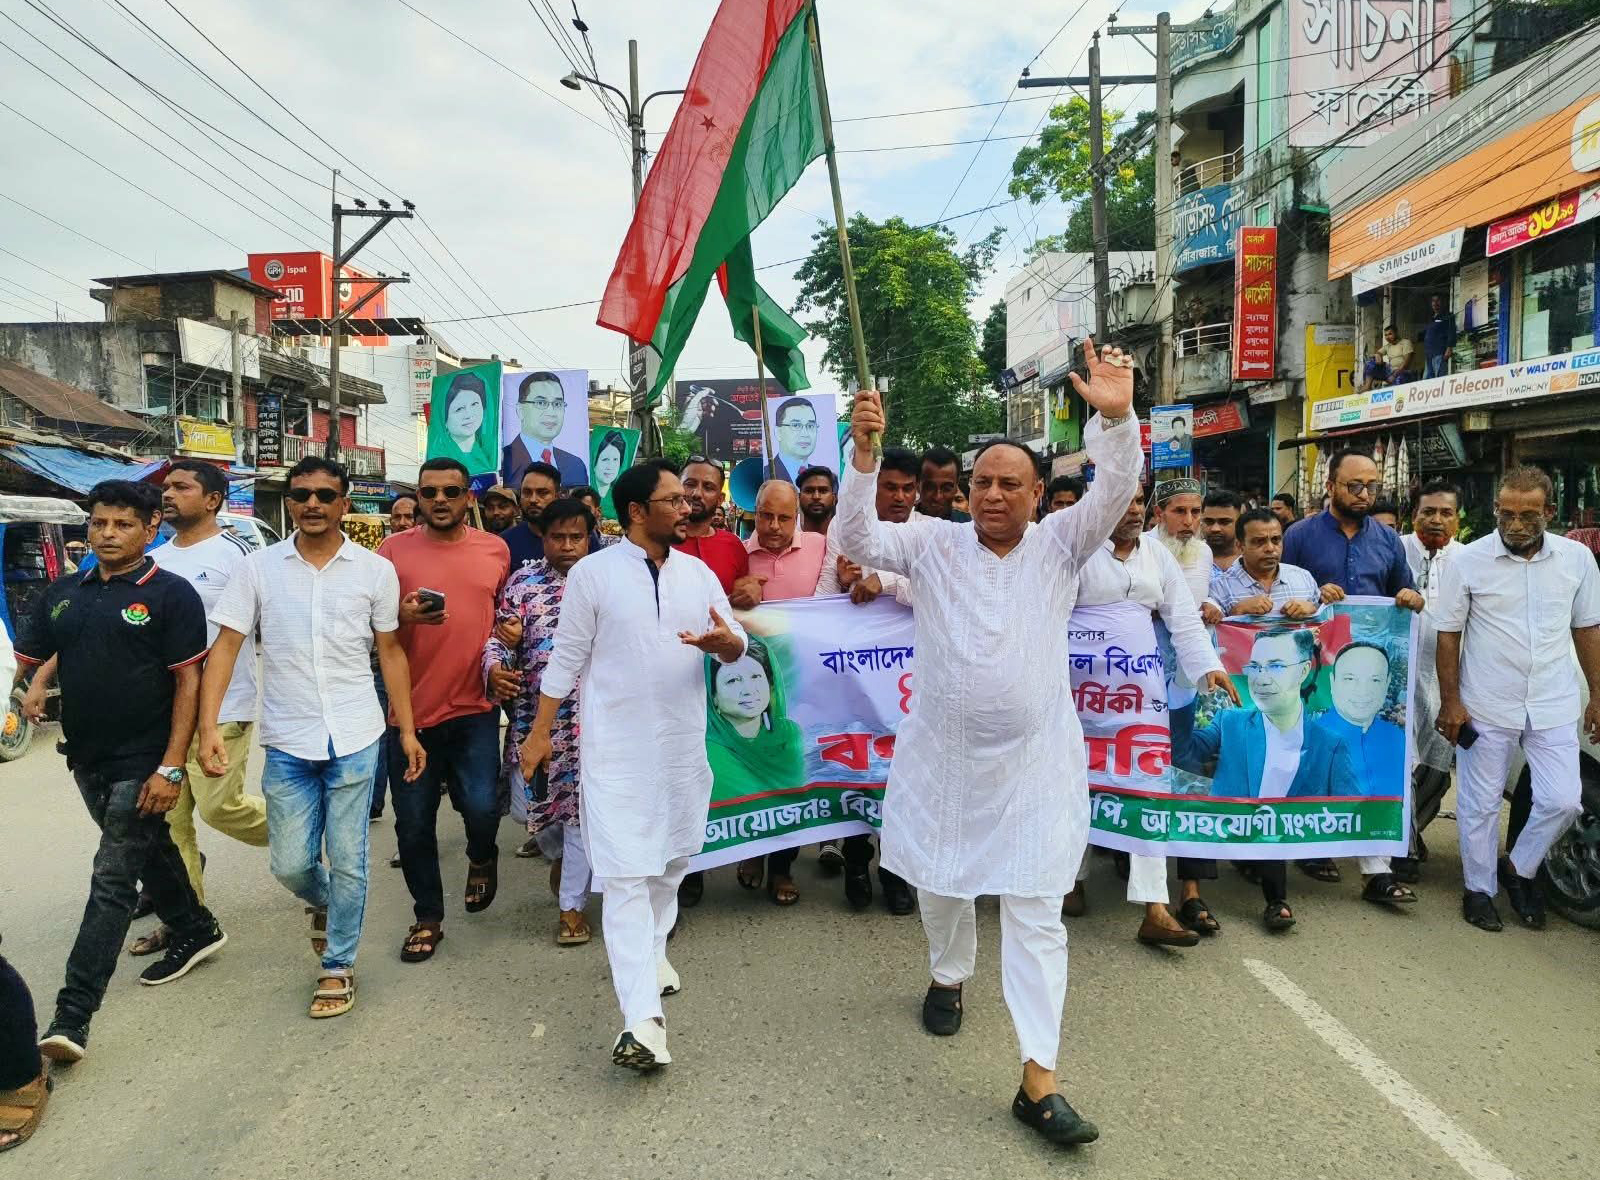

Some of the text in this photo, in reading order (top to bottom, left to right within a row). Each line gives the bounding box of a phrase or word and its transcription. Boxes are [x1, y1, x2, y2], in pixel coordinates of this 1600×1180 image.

[267, 265, 307, 275] GPH ispat
[1378, 244, 1436, 273] SAMSUNG
[1526, 360, 1568, 375] WALTON
[1408, 380, 1445, 403] Royal
[1449, 375, 1505, 395] Telecom
[1175, 805, 1276, 839] সহযোগী
